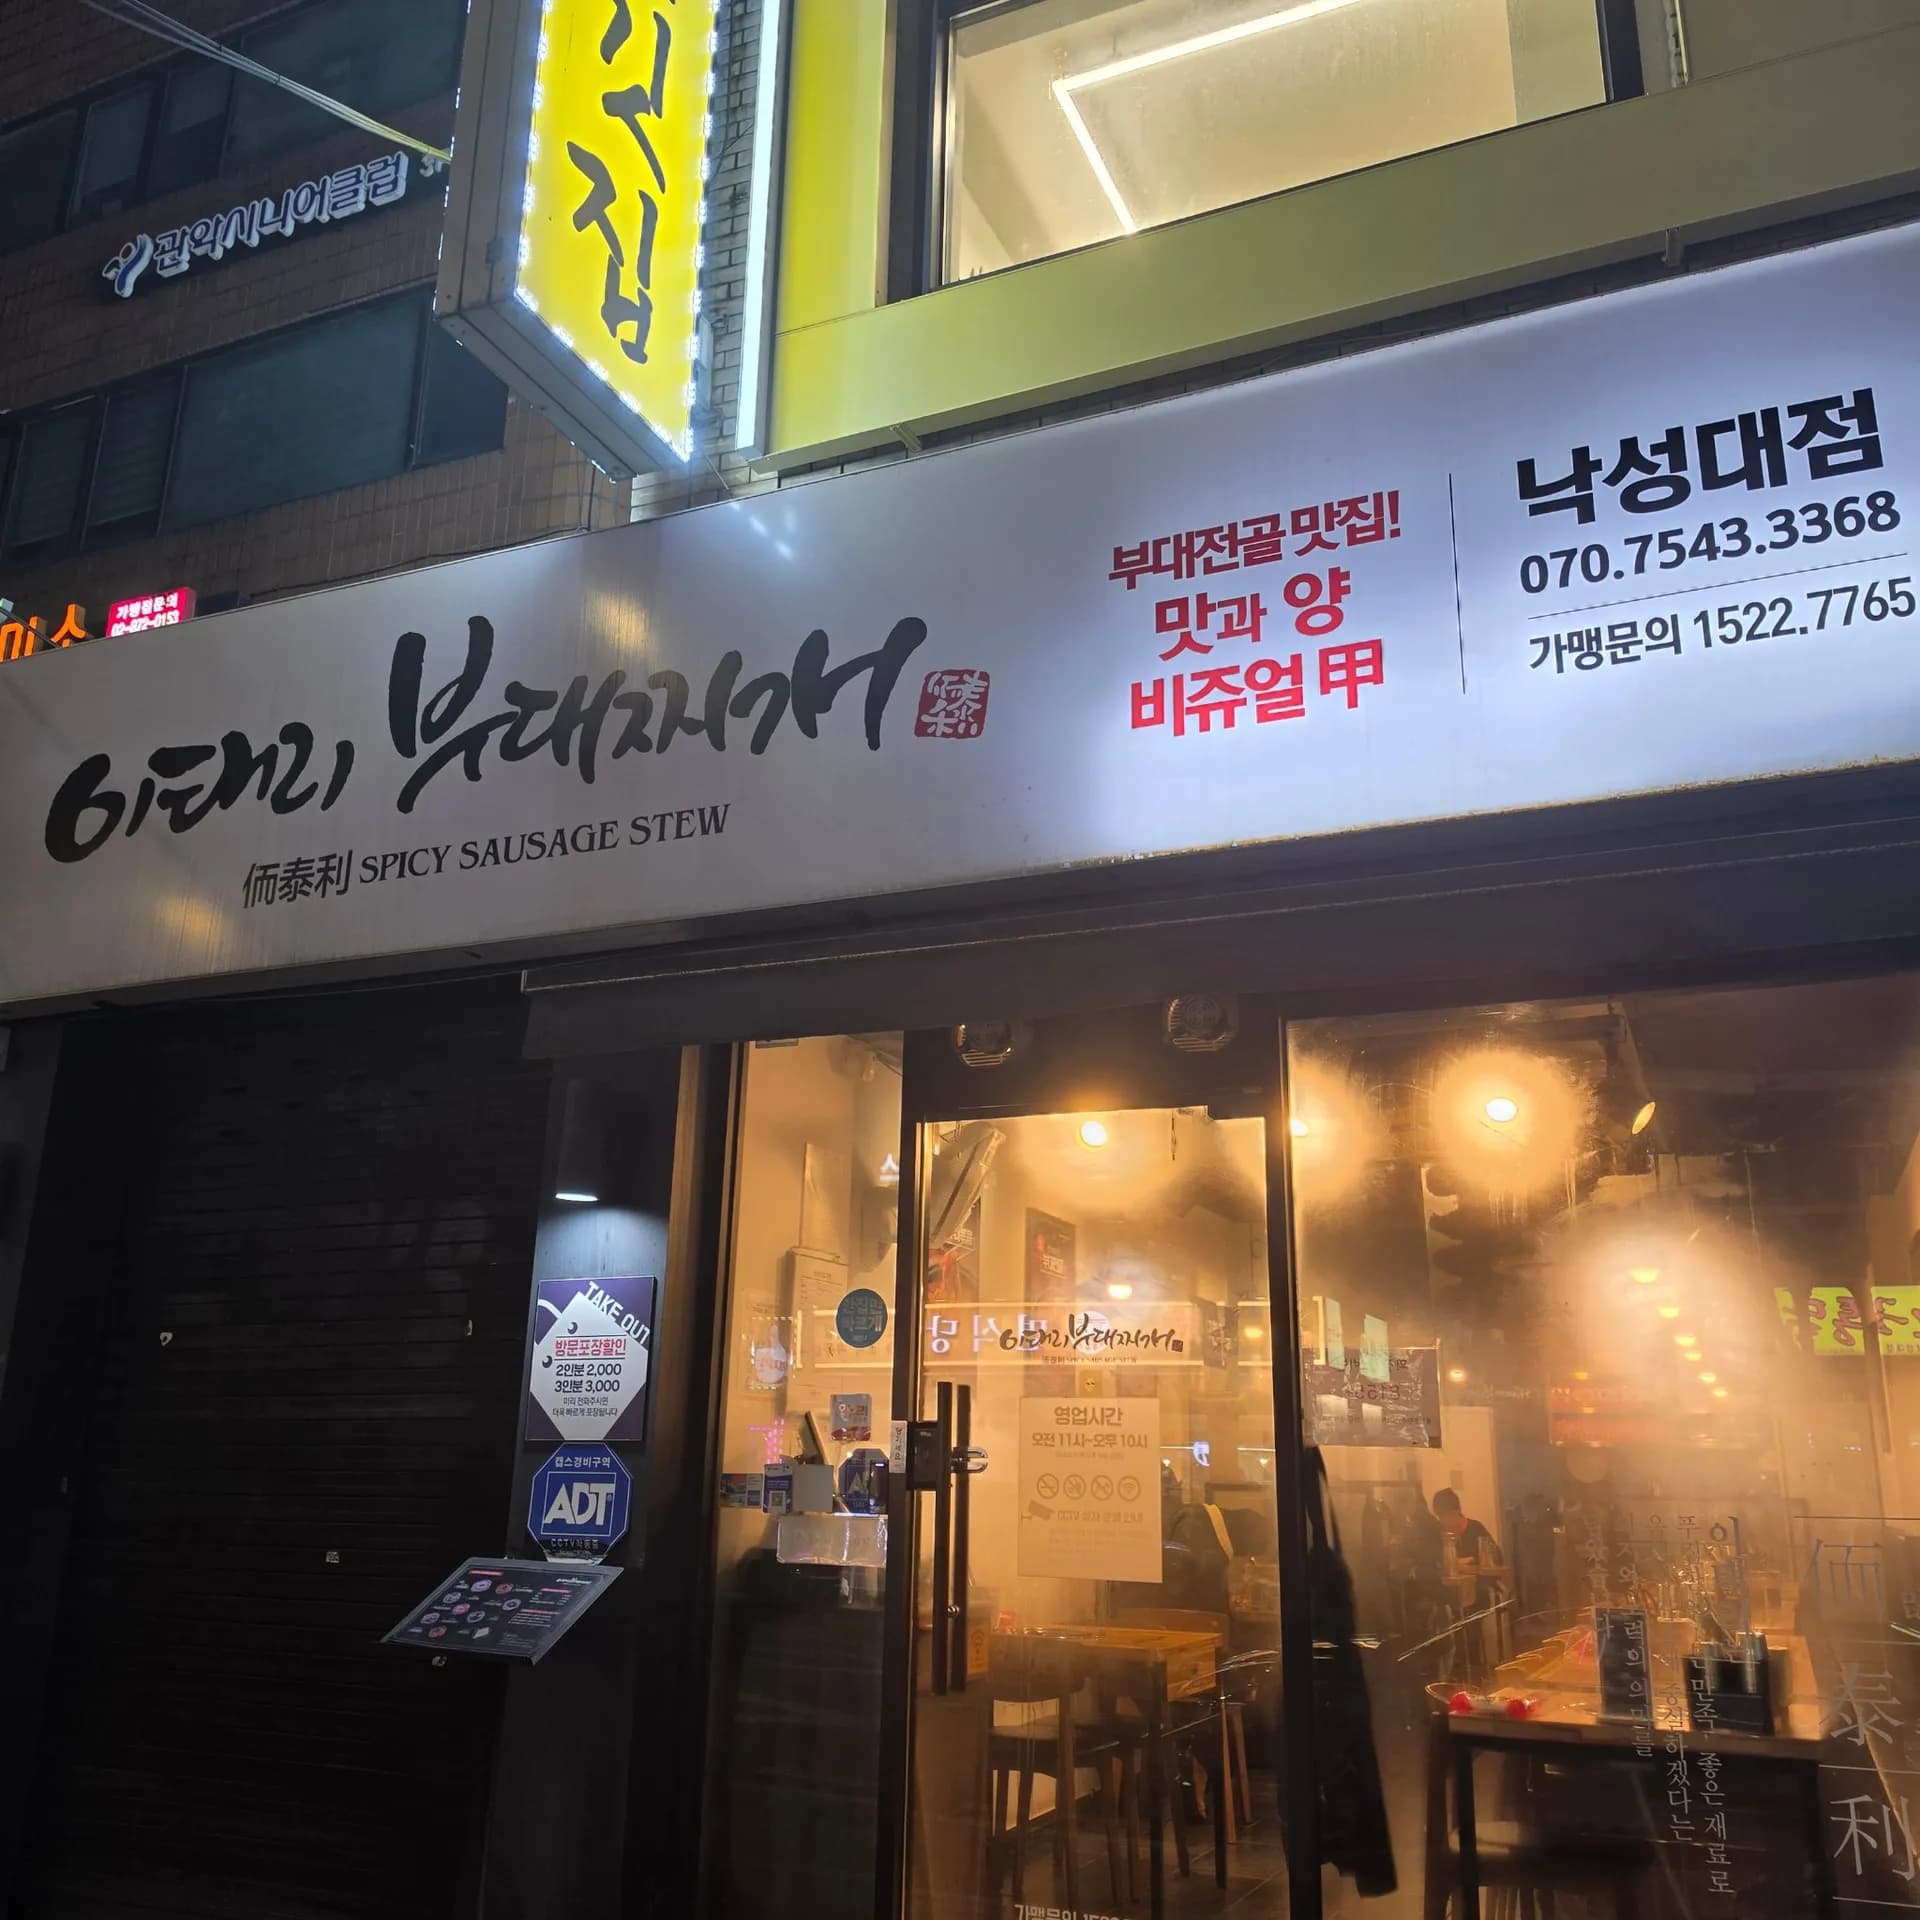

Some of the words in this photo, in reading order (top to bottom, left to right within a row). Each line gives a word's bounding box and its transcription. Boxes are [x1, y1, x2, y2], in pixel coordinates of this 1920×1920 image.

[153, 151, 409, 278] 관악시니어클럽
[1516, 387, 1884, 525] 낙성대점
[1107, 512, 1287, 591] 부대전골
[1290, 489, 1401, 556] 맛집!
[1519, 489, 1901, 595] 070.7543.3368
[1154, 591, 1268, 662] 맛과
[1283, 566, 1352, 636] 양
[1528, 613, 1682, 674] 가맹문의
[1692, 576, 1917, 649] 1522.7765
[1130, 653, 1307, 737] 비쥬얼
[1318, 638, 1384, 709] 甲
[44, 721, 355, 864] 이태리
[388, 615, 928, 815] 부대찌개
[359, 844, 452, 885] SPICY
[458, 820, 619, 871] SAUSAGE
[629, 803, 731, 846] STEW
[555, 1338, 627, 1357] 방문포장할인
[583, 1280, 624, 1323] TAKE
[620, 1312, 651, 1346] OUT
[1068, 1312, 1176, 1352] 부대찌개
[554, 1379, 583, 1393] 3인분
[585, 1379, 620, 1394] 3,000
[556, 1363, 585, 1377] 2인분
[586, 1363, 622, 1377] 2,000
[1031, 1432, 1056, 1448] 오전
[1120, 1433, 1148, 1449] 10시
[1053, 1406, 1123, 1427] 영업시간
[555, 1455, 611, 1469] 캡스경비구역
[543, 1482, 616, 1526] ADT
[1696, 1751, 1726, 1806] 좋은
[1703, 1811, 1738, 1893] 재료로
